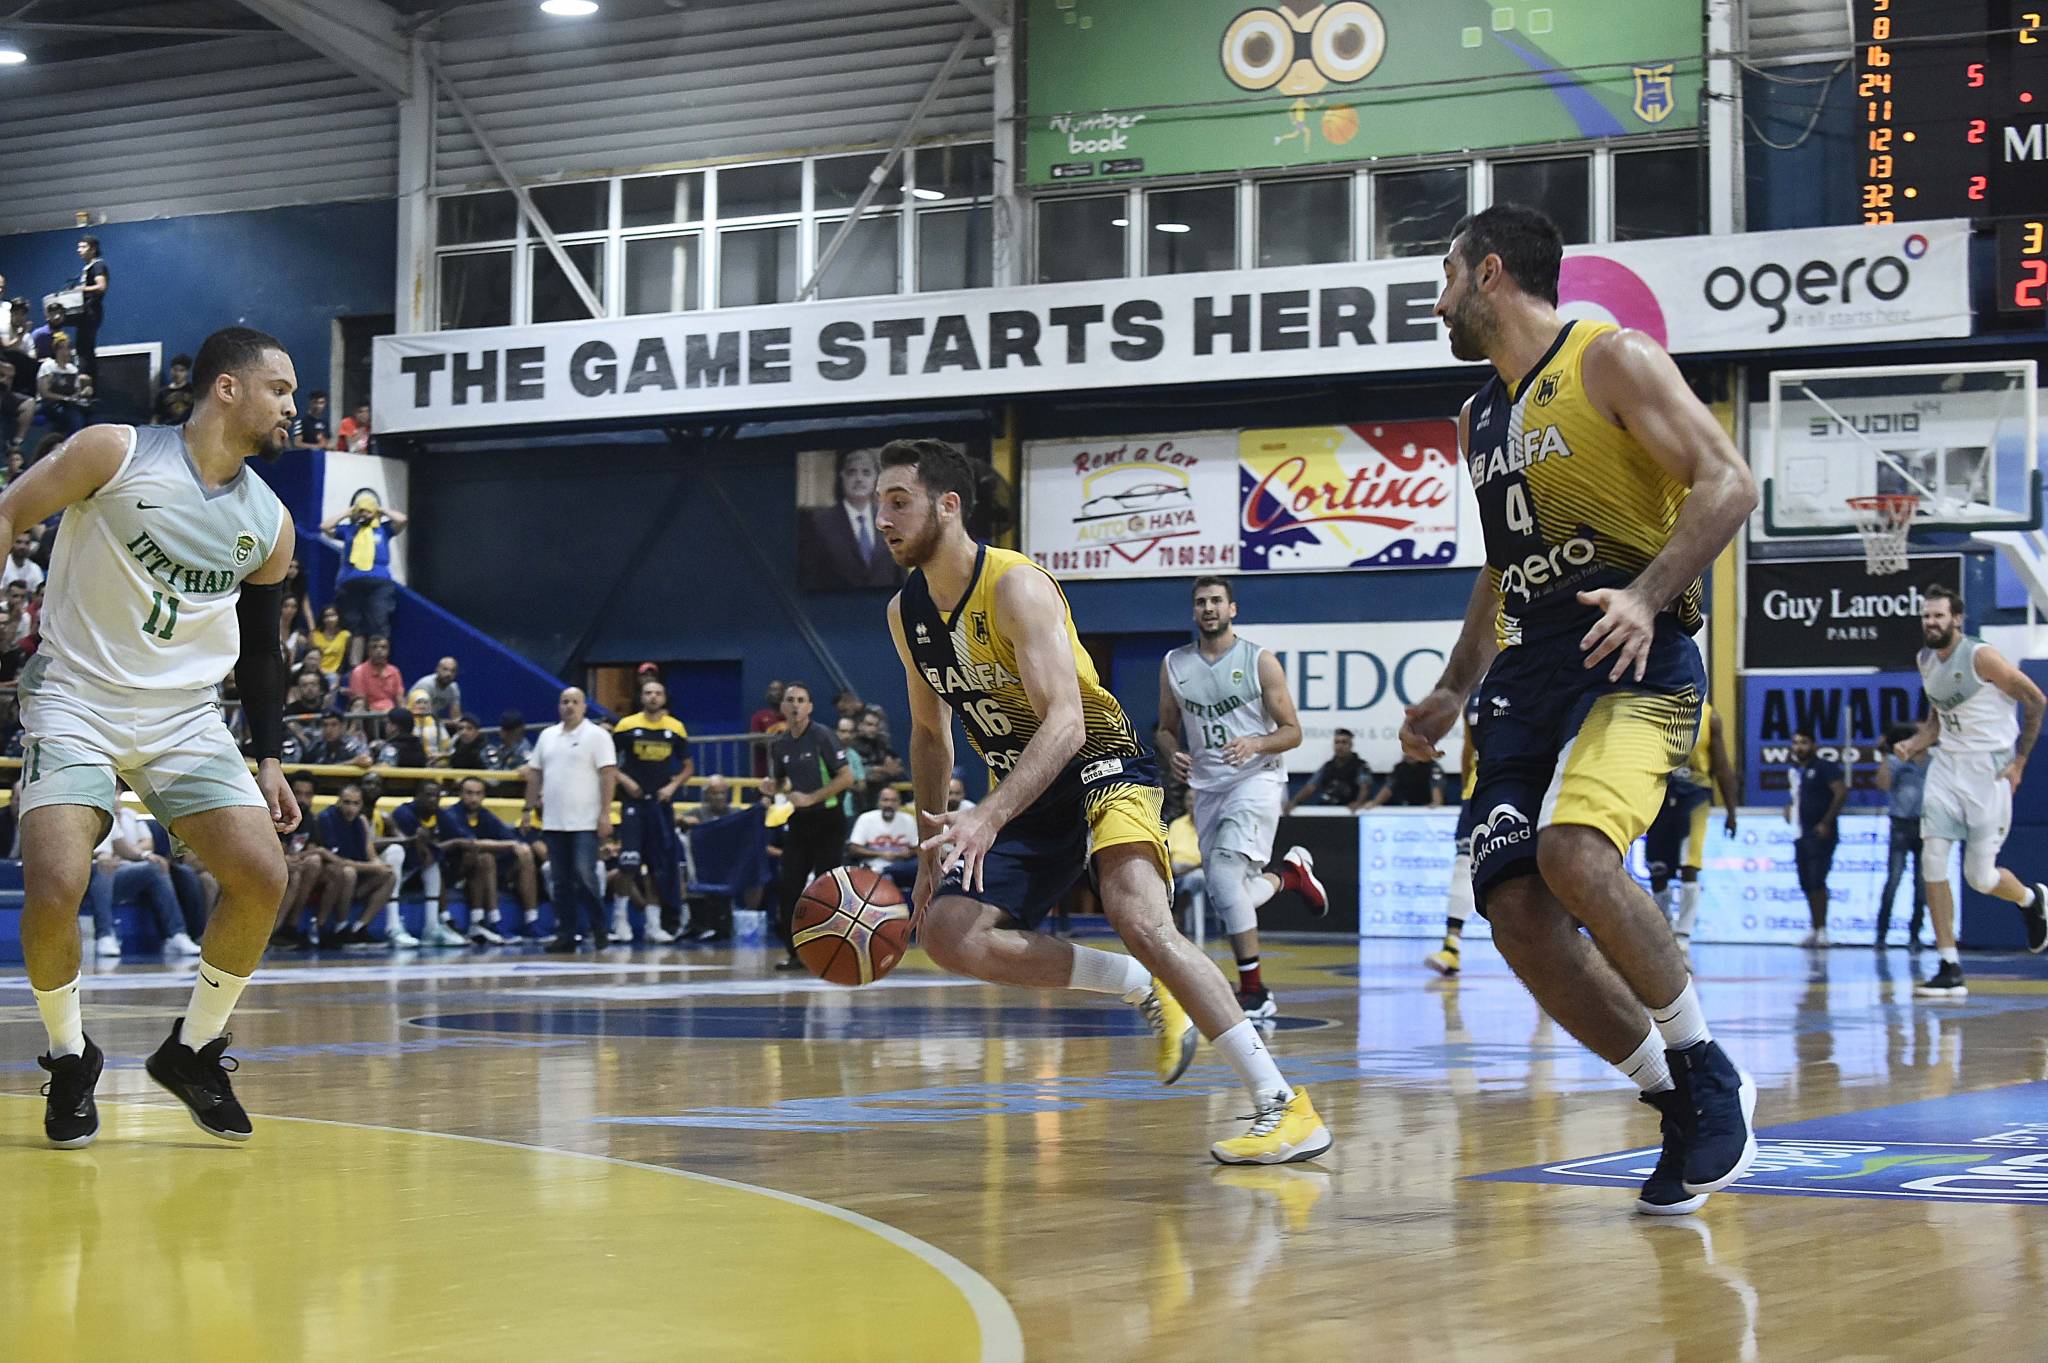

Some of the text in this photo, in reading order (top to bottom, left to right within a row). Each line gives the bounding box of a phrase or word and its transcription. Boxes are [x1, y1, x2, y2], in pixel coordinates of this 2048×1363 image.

[1873, 16, 1891, 40] 8
[2019, 14, 2041, 44] 2
[1867, 46, 1890, 67] 16
[1859, 73, 1892, 97] 24
[1967, 64, 1985, 87] 5
[1049, 110, 1146, 133] Number
[1868, 100, 1892, 122] 11
[1069, 129, 1128, 154] book
[1869, 128, 1893, 151] 12
[1968, 120, 1986, 143] 2
[2003, 123, 2048, 163] M
[1869, 155, 1893, 178] 13
[1862, 184, 1894, 208] 32
[1968, 176, 1987, 199] 2
[2022, 222, 2044, 254] 3
[1704, 256, 1909, 333] ogero
[401, 279, 1439, 407] THE GAME STARTS HERE
[1810, 413, 1920, 437] STUDIO
[1073, 441, 1198, 475] Rent a Car
[1247, 457, 1450, 529] Cortina
[1150, 509, 1197, 529] HAYA
[1506, 482, 1533, 536] 4
[127, 531, 236, 593] ITTIHAD
[1159, 547, 1175, 566] 70
[142, 591, 180, 640] 11
[1763, 589, 1823, 626] Guy
[1827, 627, 1879, 641] PARIS
[963, 699, 1013, 737] 16
[1203, 725, 1227, 749] 13
[1762, 748, 1860, 763] WOD
